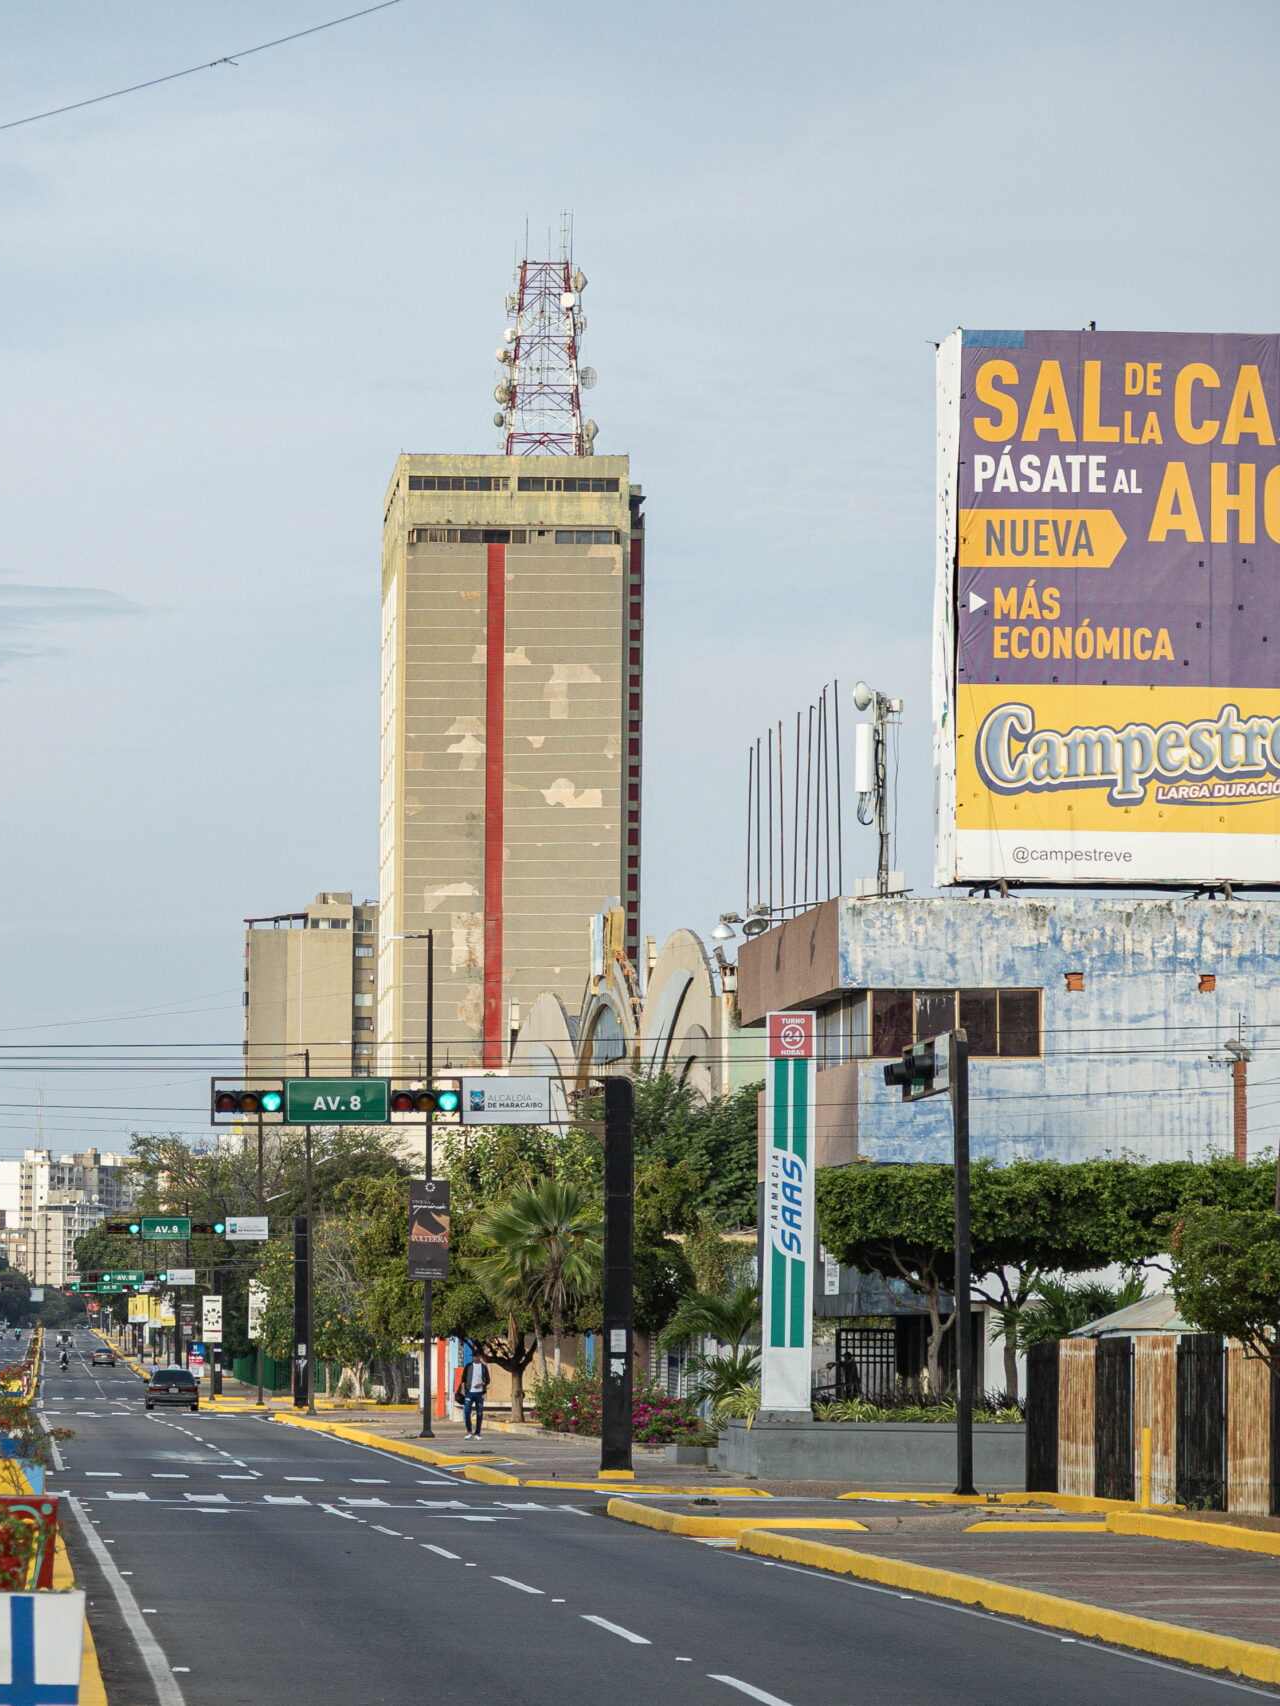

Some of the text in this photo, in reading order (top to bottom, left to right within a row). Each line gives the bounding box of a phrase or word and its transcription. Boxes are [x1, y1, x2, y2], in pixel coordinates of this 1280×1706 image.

[1125, 362, 1162, 396] DE
[974, 360, 1120, 442] SAL
[1174, 363, 1280, 445] CA
[1124, 411, 1163, 444] LA
[974, 445, 1143, 493] PÁSATE AL
[986, 520, 1094, 556] NUEVA
[993, 579, 1061, 620] MÁS
[993, 618, 1175, 661] ECONÓMICA
[1157, 785, 1210, 800] LARGA
[1012, 846, 1133, 864] @campestreve
[785, 1030, 801, 1042] 24
[313, 1096, 362, 1111] AV. 8
[487, 1093, 532, 1102] ALCALDÍA
[771, 1155, 780, 1230] FARMACIA
[781, 1157, 803, 1255] SAAS
[154, 1225, 179, 1234] AV. 9
[410, 1234, 449, 1243] VOLTERRA
